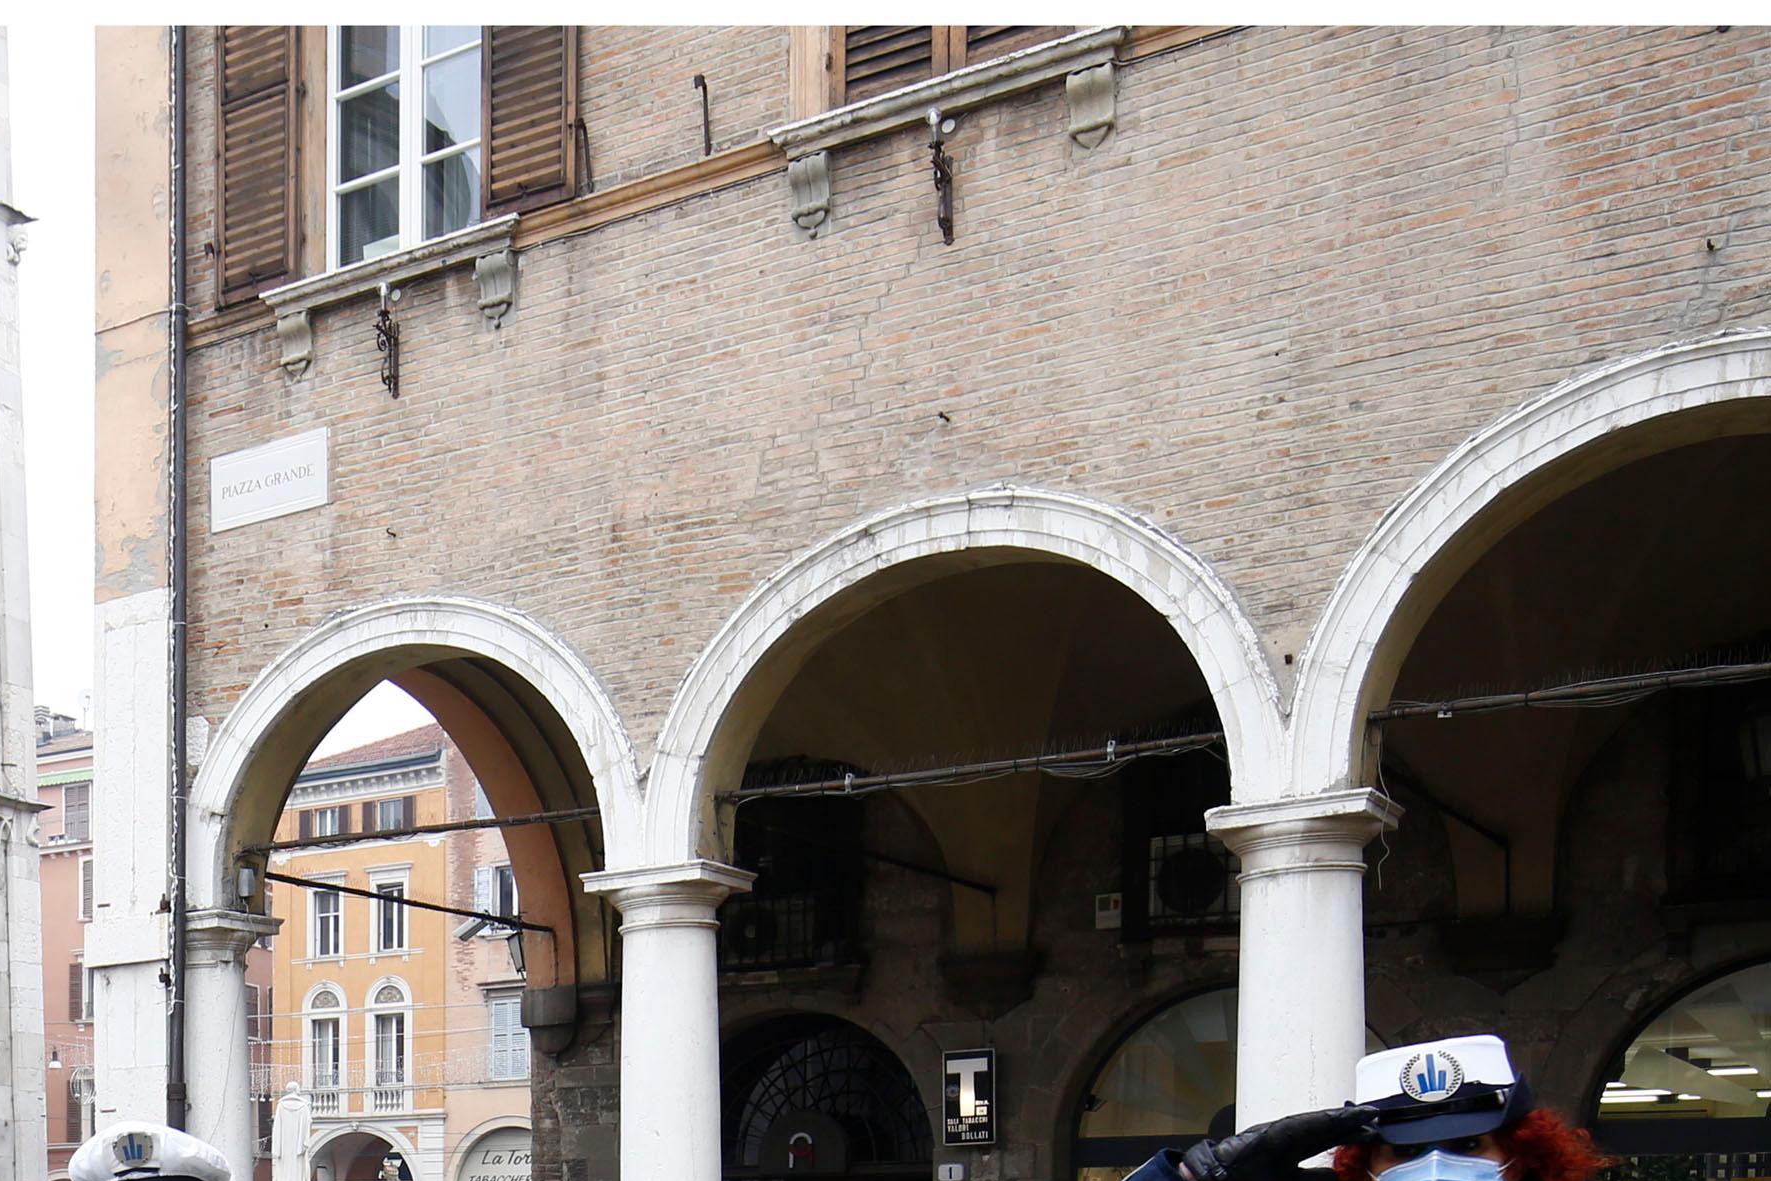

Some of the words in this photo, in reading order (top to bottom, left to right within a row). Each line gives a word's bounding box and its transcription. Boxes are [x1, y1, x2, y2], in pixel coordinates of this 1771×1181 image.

[221, 479, 262, 500] PIAZZA
[264, 463, 315, 488] GRANDE
[946, 1057, 988, 1117] T
[962, 1116, 988, 1124] TABACCHI
[961, 1131, 988, 1141] BOLLATI
[481, 1150, 504, 1166] La
